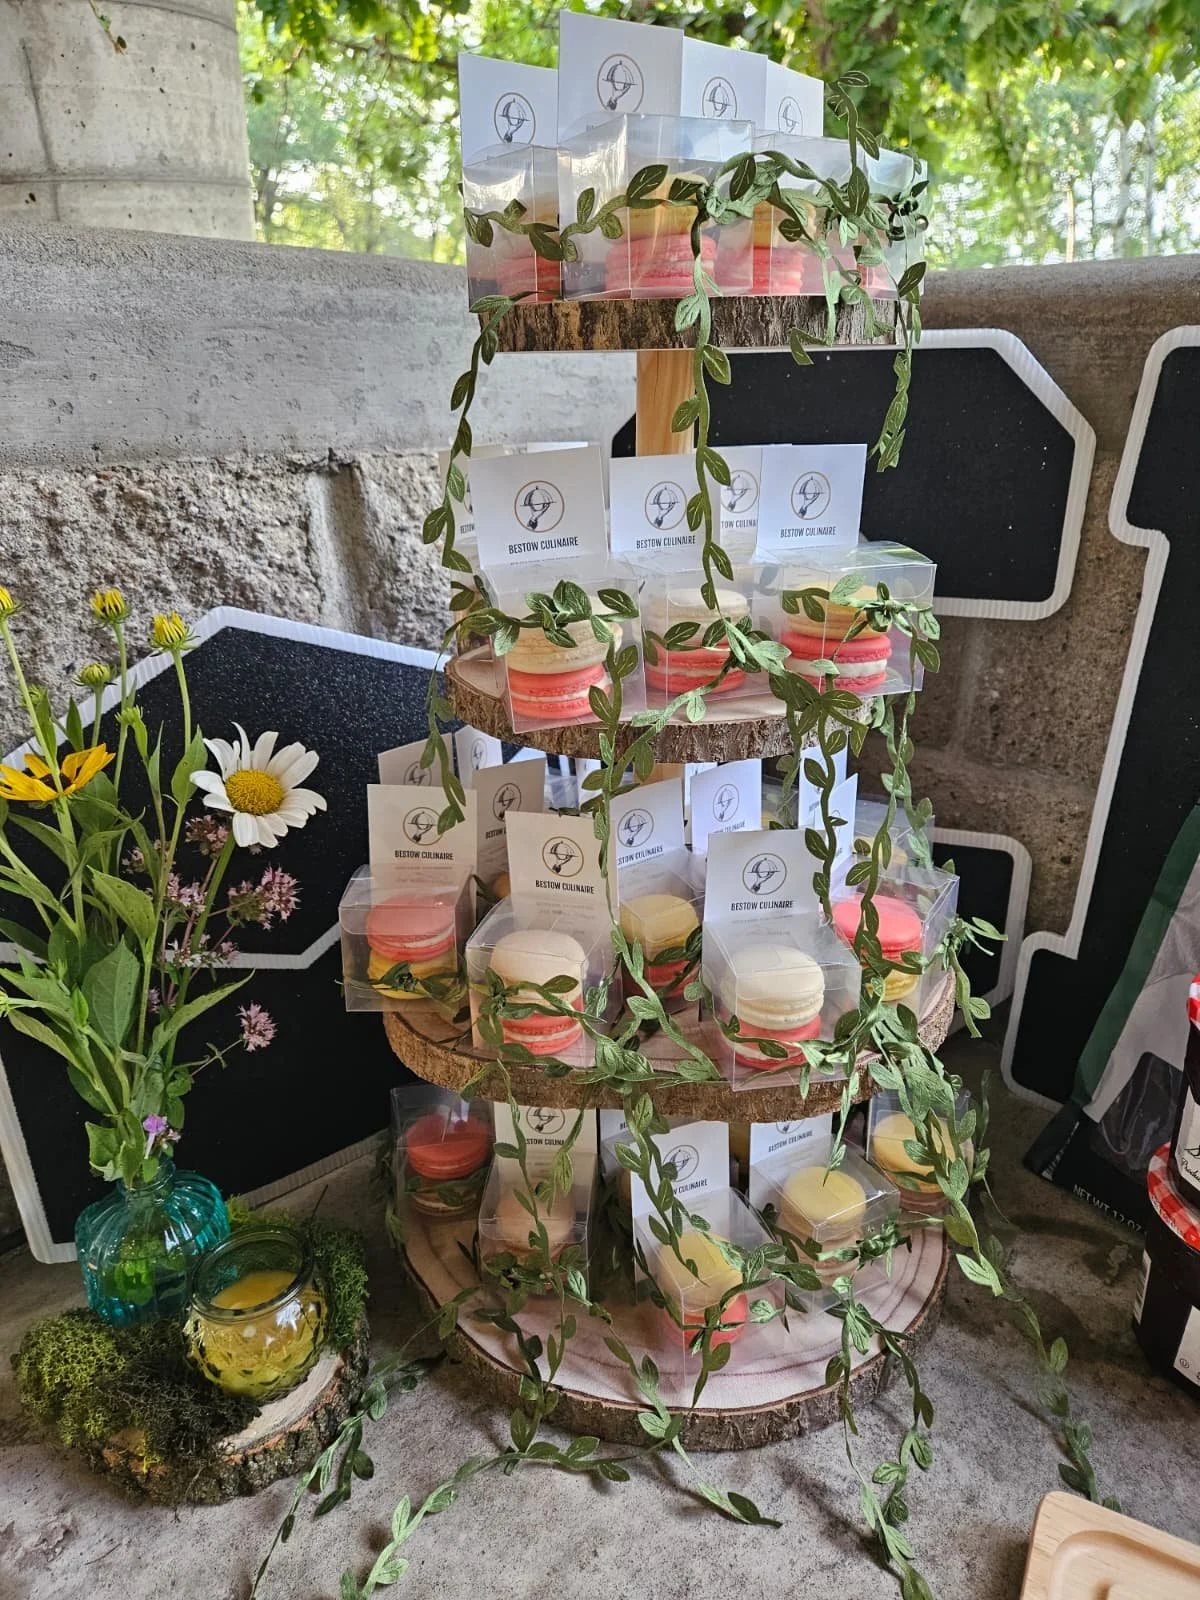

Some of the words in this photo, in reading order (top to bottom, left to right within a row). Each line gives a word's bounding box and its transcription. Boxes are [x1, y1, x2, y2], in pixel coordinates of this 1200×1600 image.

[721, 519, 734, 529] TOW
[735, 519, 758, 528] CULINA
[780, 527, 804, 538] BESTOW
[805, 526, 837, 537] CULINAIRE
[508, 541, 539, 555] BESTOW
[540, 536, 579, 550] CULINAIRE
[636, 537, 661, 549] BESTOW
[663, 535, 696, 547] CULINAIRE
[395, 850, 420, 858] BESTOW
[421, 851, 454, 860] CULINAIRE
[616, 855, 634, 866] STOW
[635, 845, 663, 860] CULINAIRE
[535, 880, 561, 890] BESTOW
[562, 882, 595, 894] CULINAIRE
[731, 902, 758, 911] BESTOW
[759, 900, 793, 910] CULINAIRE
[545, 1138, 565, 1146] CULINA
[768, 1140, 787, 1153] BESTOW
[788, 1130, 813, 1144] CULINAIRE
[678, 1178, 708, 1193] CULINAIRE
